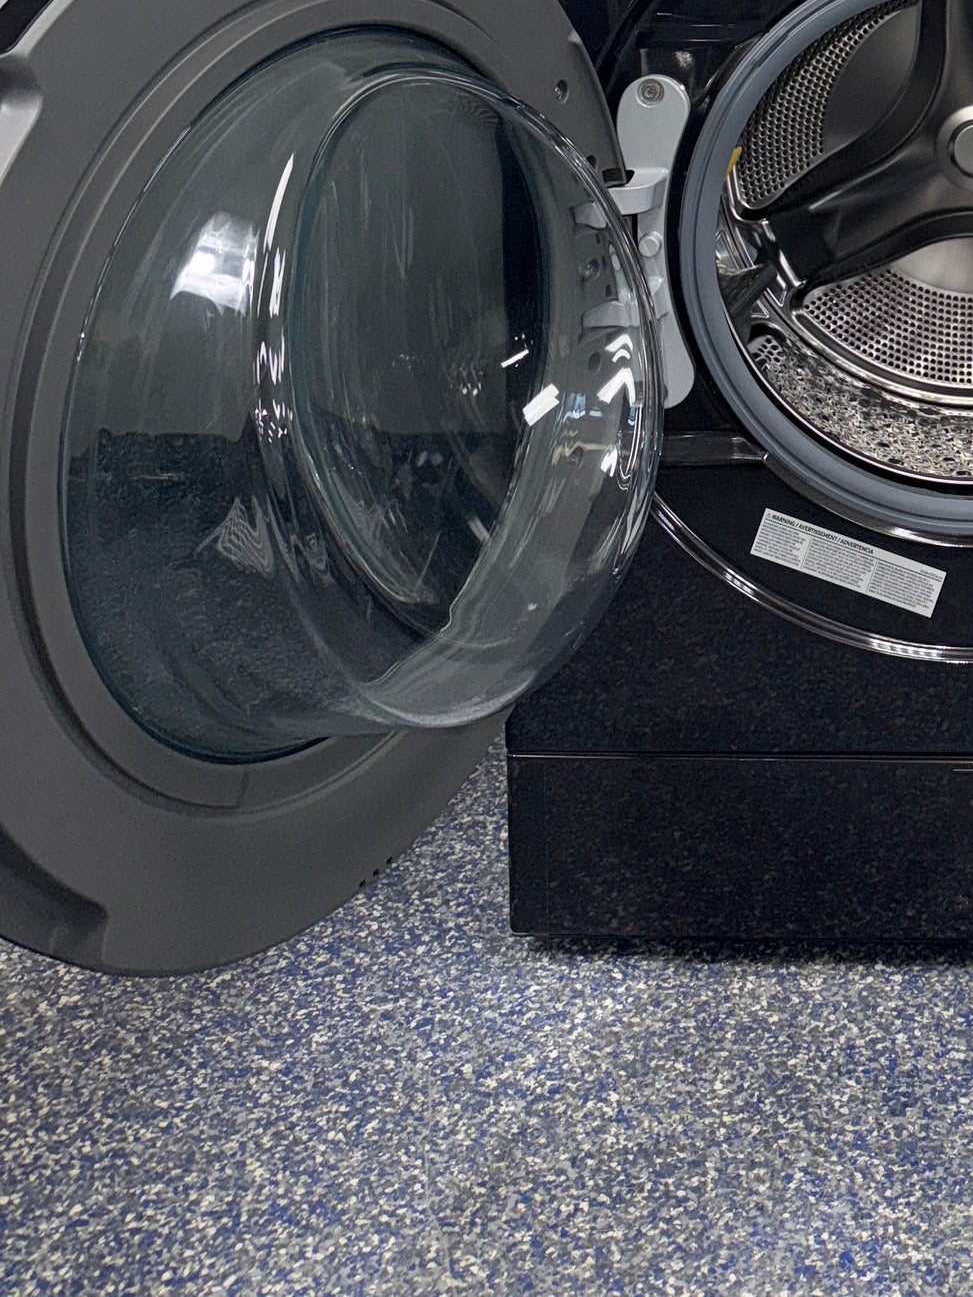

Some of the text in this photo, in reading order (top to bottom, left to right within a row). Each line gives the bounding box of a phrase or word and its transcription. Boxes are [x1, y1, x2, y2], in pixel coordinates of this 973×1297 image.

[771, 514, 796, 527] WARNING
[798, 523, 838, 542] AVERTISSEMENT
[840, 537, 874, 555] ADVERTENCIA
